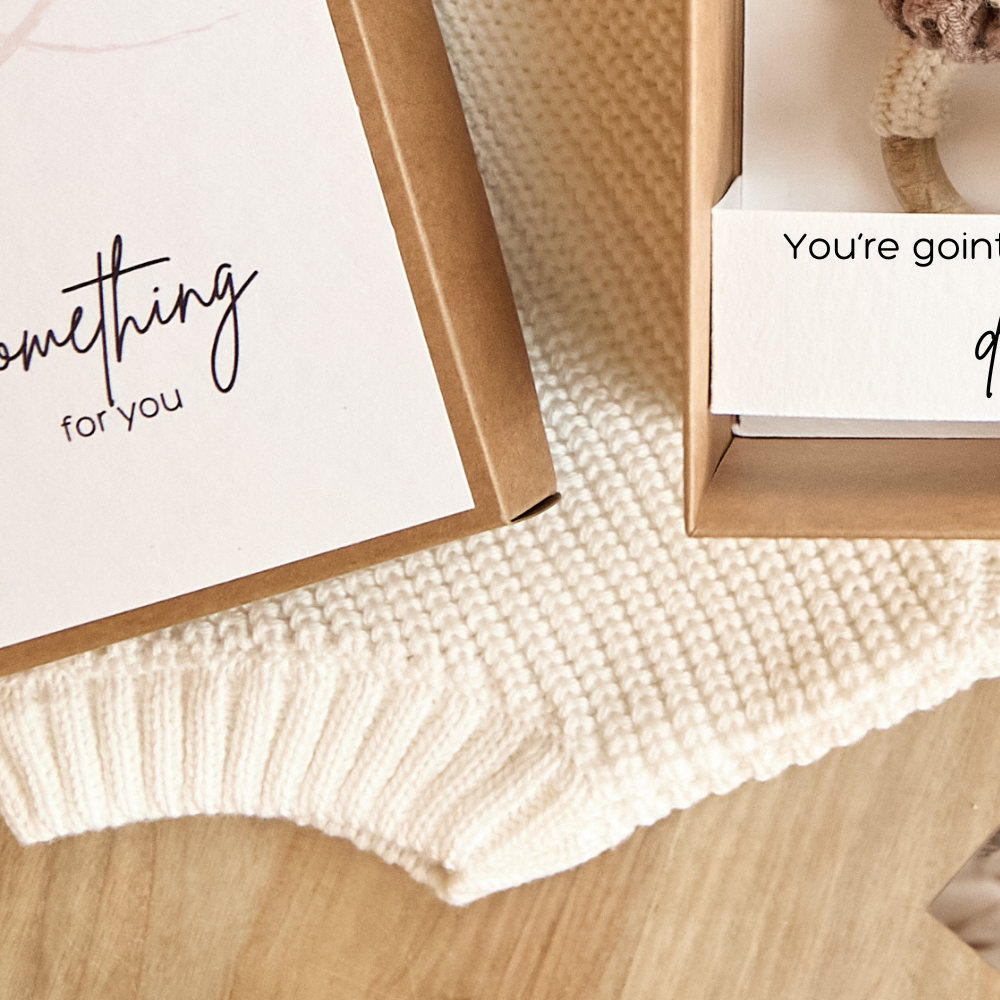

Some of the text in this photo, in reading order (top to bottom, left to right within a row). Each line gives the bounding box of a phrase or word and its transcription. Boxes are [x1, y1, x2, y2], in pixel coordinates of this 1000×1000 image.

[783, 231, 900, 260] You're
[60, 388, 183, 442] for you
